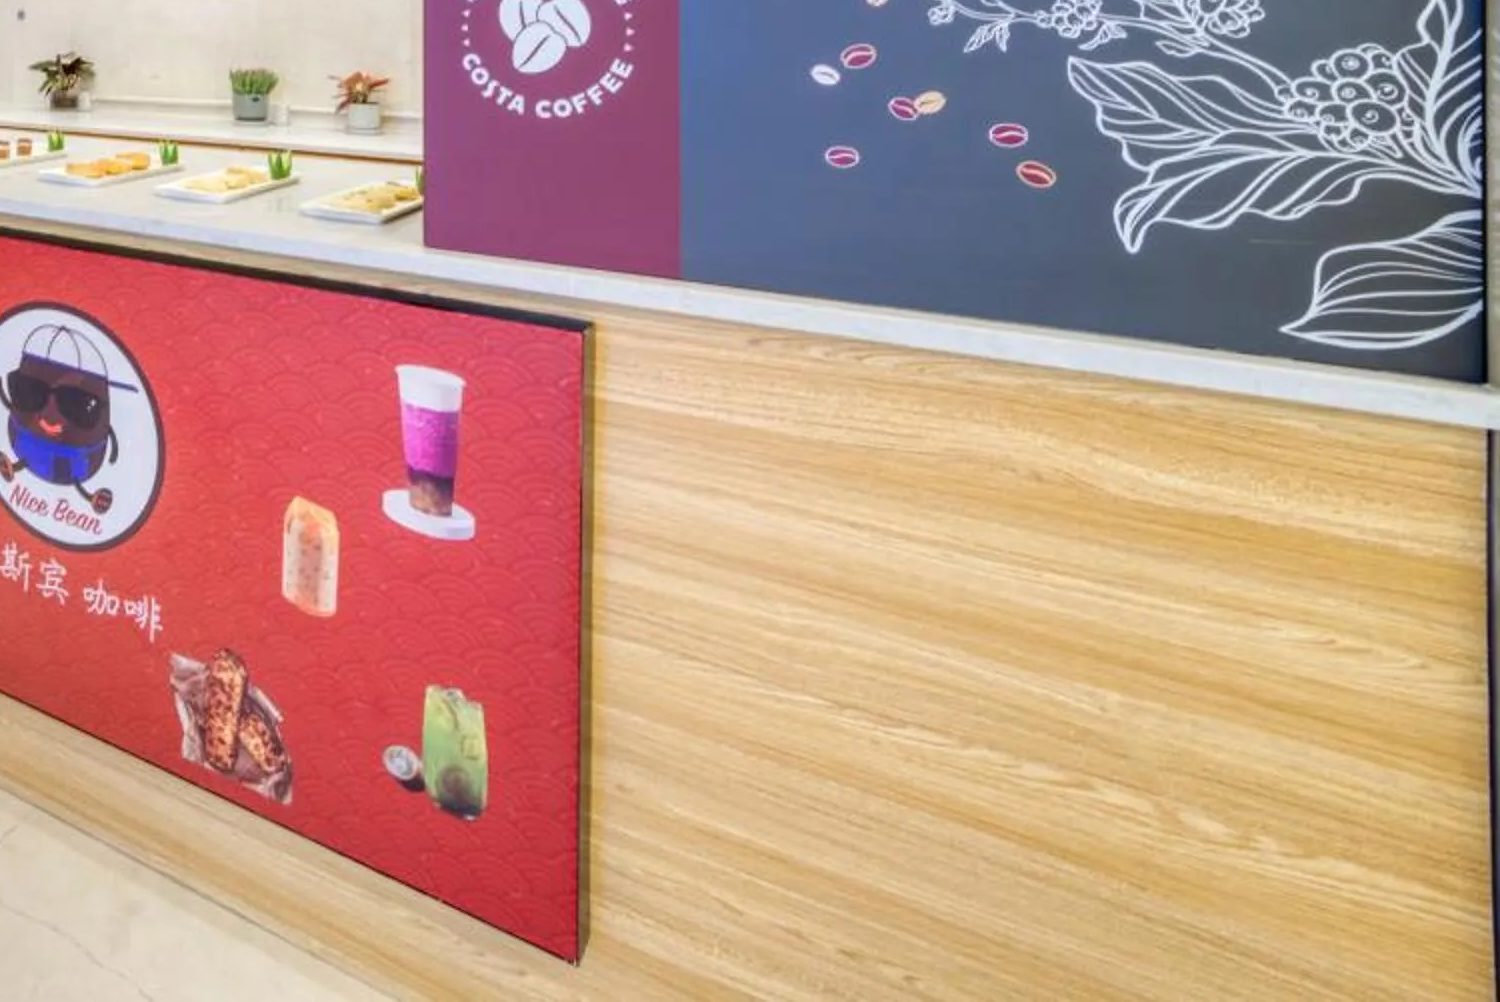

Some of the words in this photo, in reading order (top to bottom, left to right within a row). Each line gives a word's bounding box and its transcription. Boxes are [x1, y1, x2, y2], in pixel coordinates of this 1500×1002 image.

[462, 53, 525, 115] COSTA
[535, 58, 635, 119] COFFEE
[9, 482, 49, 517] Nice
[53, 496, 103, 536] Bean
[83, 579, 164, 643] 咖啡
